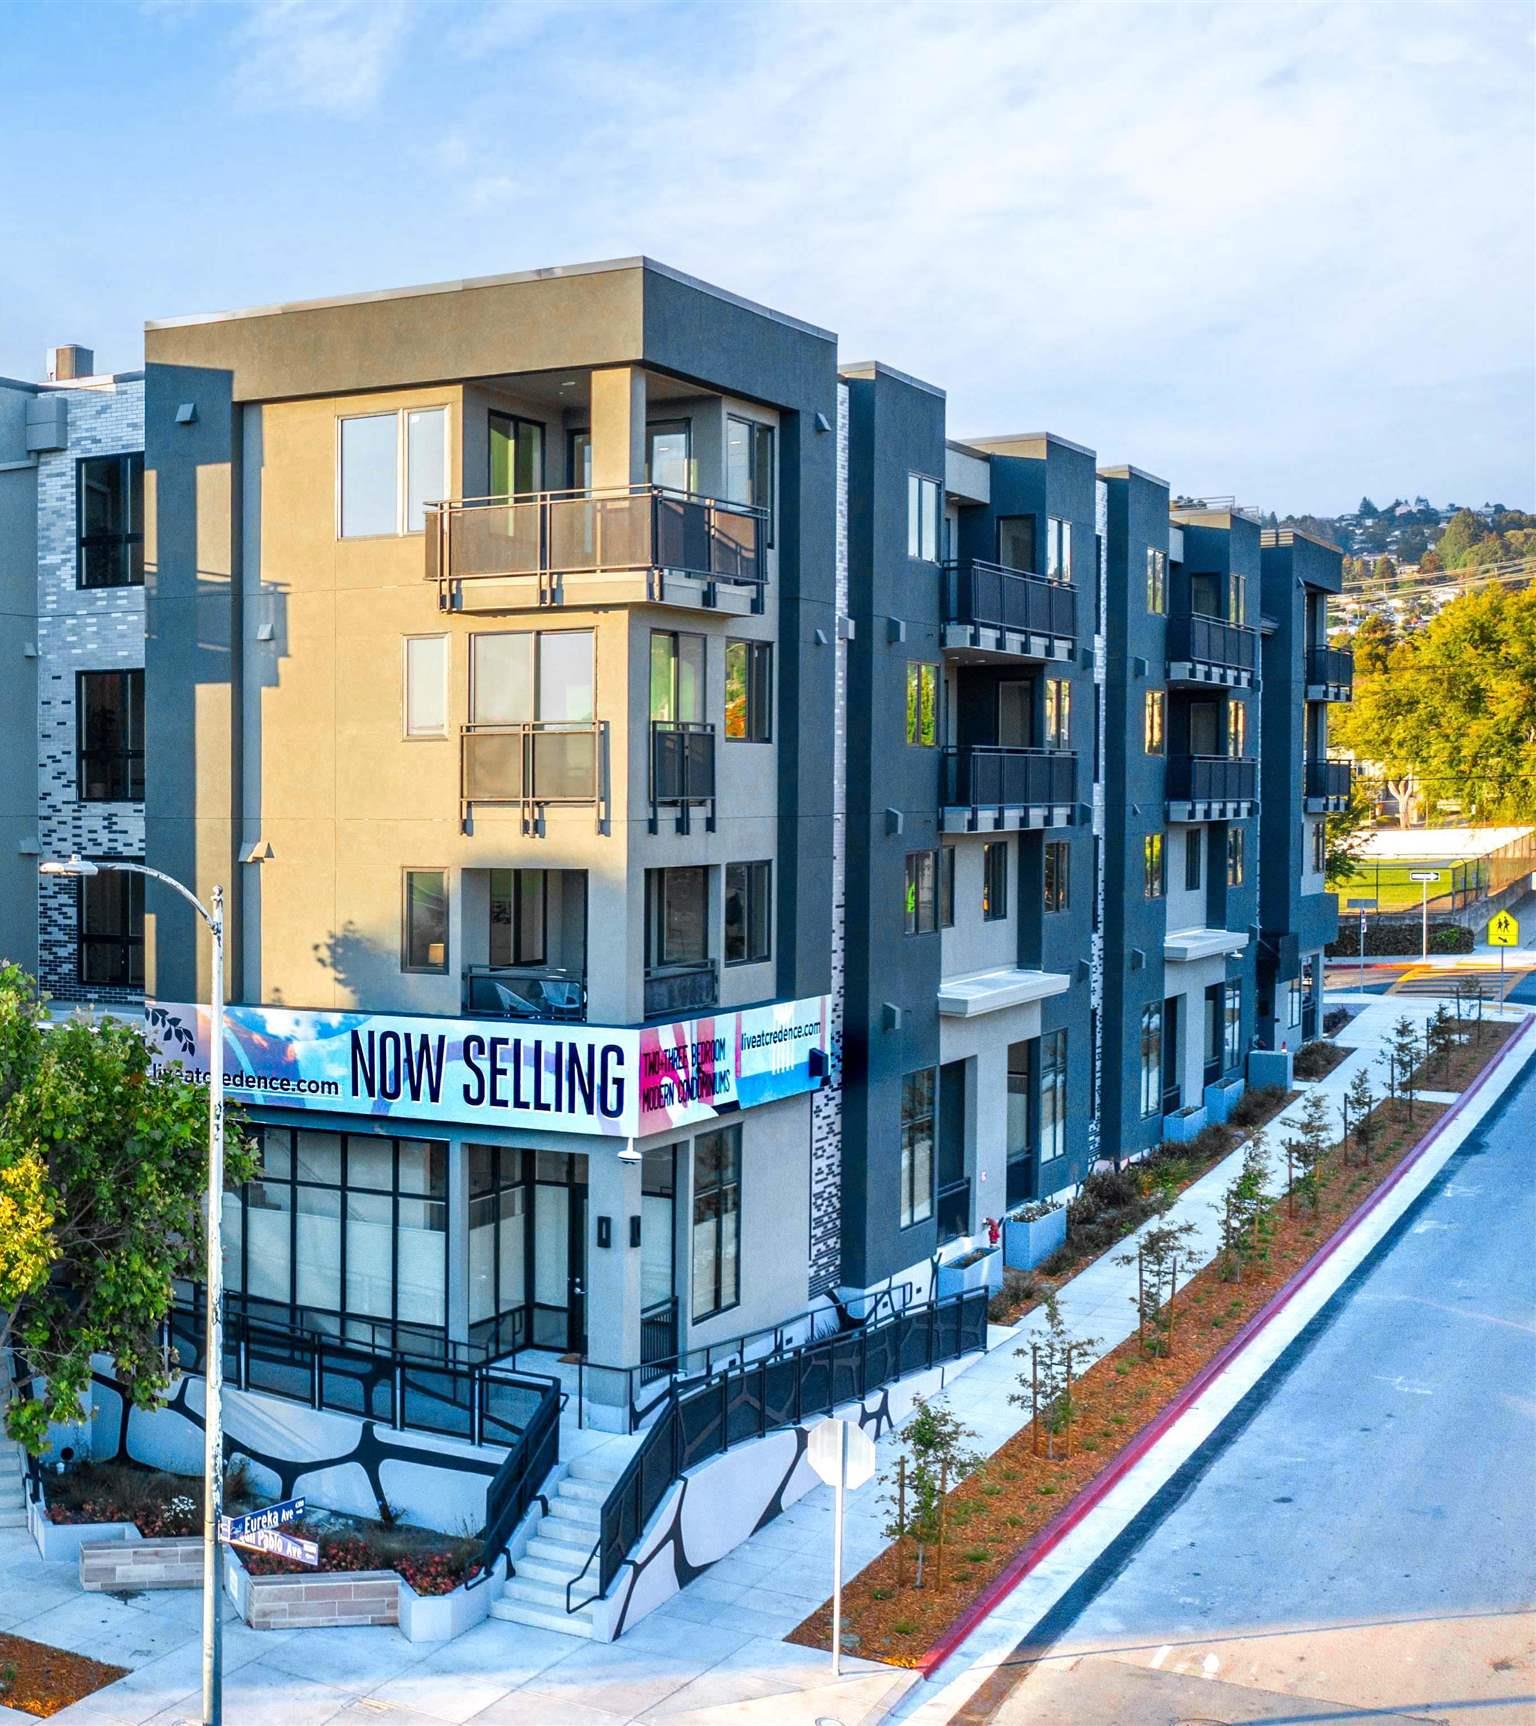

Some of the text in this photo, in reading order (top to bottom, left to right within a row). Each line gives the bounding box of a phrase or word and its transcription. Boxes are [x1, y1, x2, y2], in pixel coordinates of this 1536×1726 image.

[741, 1021, 821, 1051] liveatcredence.com
[691, 1037, 726, 1067] BEDROOM
[153, 1063, 339, 1095] lieatcedence.com
[350, 1029, 625, 1118] NOW SELLING
[642, 1083, 674, 1112] MODERN
[245, 1510, 279, 1534] Eureka
[281, 1508, 294, 1522] Ave
[257, 1531, 283, 1554] Pablo
[286, 1541, 302, 1559] Ave
